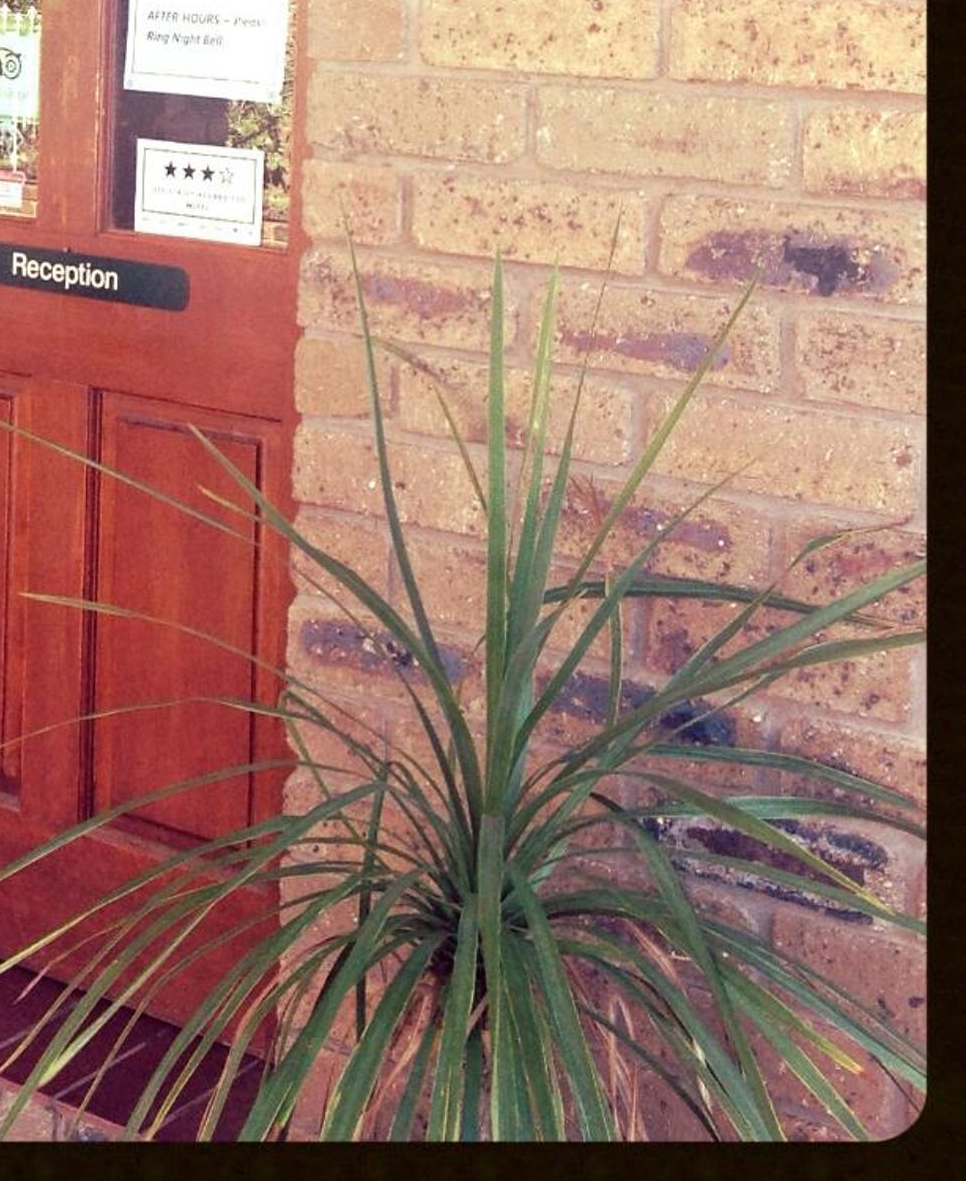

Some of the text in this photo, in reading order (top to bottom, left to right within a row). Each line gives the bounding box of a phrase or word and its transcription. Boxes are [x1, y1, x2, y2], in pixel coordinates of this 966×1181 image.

[146, 10, 180, 23] AFTER
[182, 12, 220, 25] HOURS
[146, 30, 224, 47] Ring Night Bell
[11, 250, 119, 291] Reception
